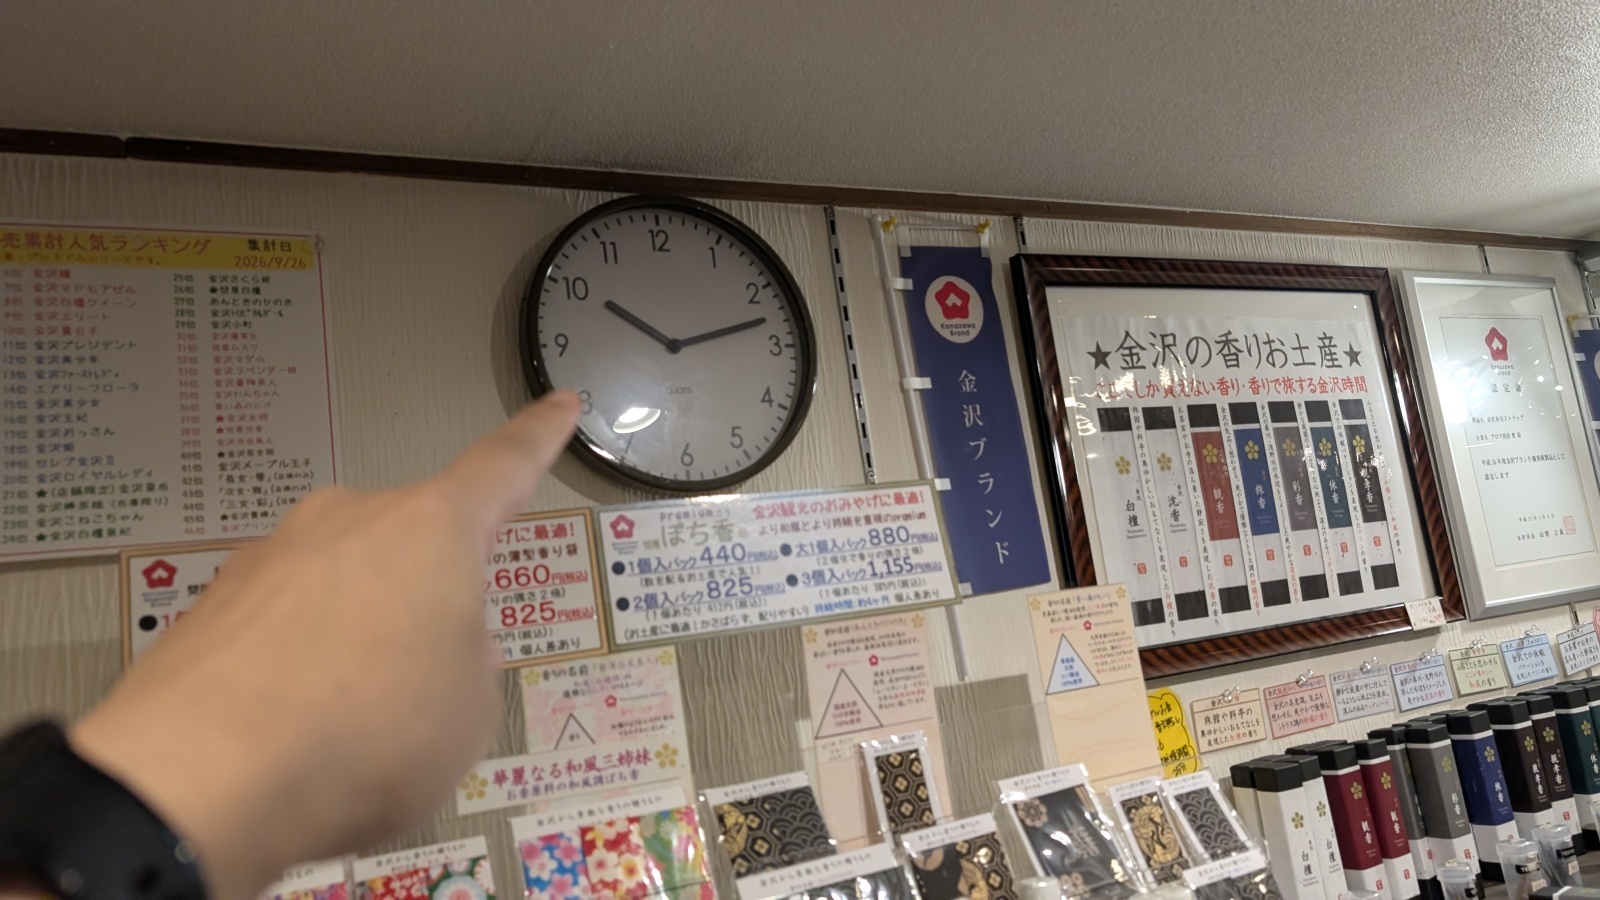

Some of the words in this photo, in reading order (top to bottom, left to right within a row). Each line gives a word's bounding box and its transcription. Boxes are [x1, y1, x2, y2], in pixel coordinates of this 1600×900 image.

[247, 239, 292, 252] 集計日
[648, 229, 671, 252] 12
[234, 256, 307, 269] 2026/9/26
[599, 241, 618, 264] 11
[708, 246, 717, 268] 1
[562, 276, 589, 301] 10
[746, 282, 761, 304] 2
[940, 322, 976, 330] Kanazawa
[950, 330, 970, 338] Brand
[553, 333, 569, 358] 9
[768, 335, 783, 357] 3
[1115, 329, 1343, 371] 金沢の香りお土産
[580, 390, 593, 415] 8
[760, 386, 774, 408] 4
[730, 426, 744, 449] 5
[680, 443, 695, 467] 6
[957, 369, 1010, 565] 金沢ブランド
[1328, 479, 1341, 505] 休香
[1126, 499, 1140, 527] 白檀
[1167, 495, 1180, 522] 沈香
[660, 518, 735, 547] ぽち香
[488, 543, 579, 565] の薄型香り袋
[519, 637, 581, 658] 個人差あり
[1511, 648, 1546, 663] 金沢での休暇
[1564, 636, 1594, 653] お茶室やお寺の
[1456, 657, 1498, 671] ふるさとを思わせる
[1518, 659, 1545, 670] バケーションを
[1469, 677, 1497, 689] 和風の香り
[1203, 707, 1253, 726] 旅館や料亭の
[1200, 718, 1261, 738] 奥ゆかしいおもてなしを
[1207, 729, 1258, 747] 表現した白檀の香り
[492, 746, 653, 787] 華麗なる和風三姉妹
[1326, 839, 1337, 863] 白檀
[1302, 851, 1313, 877] 白檀
